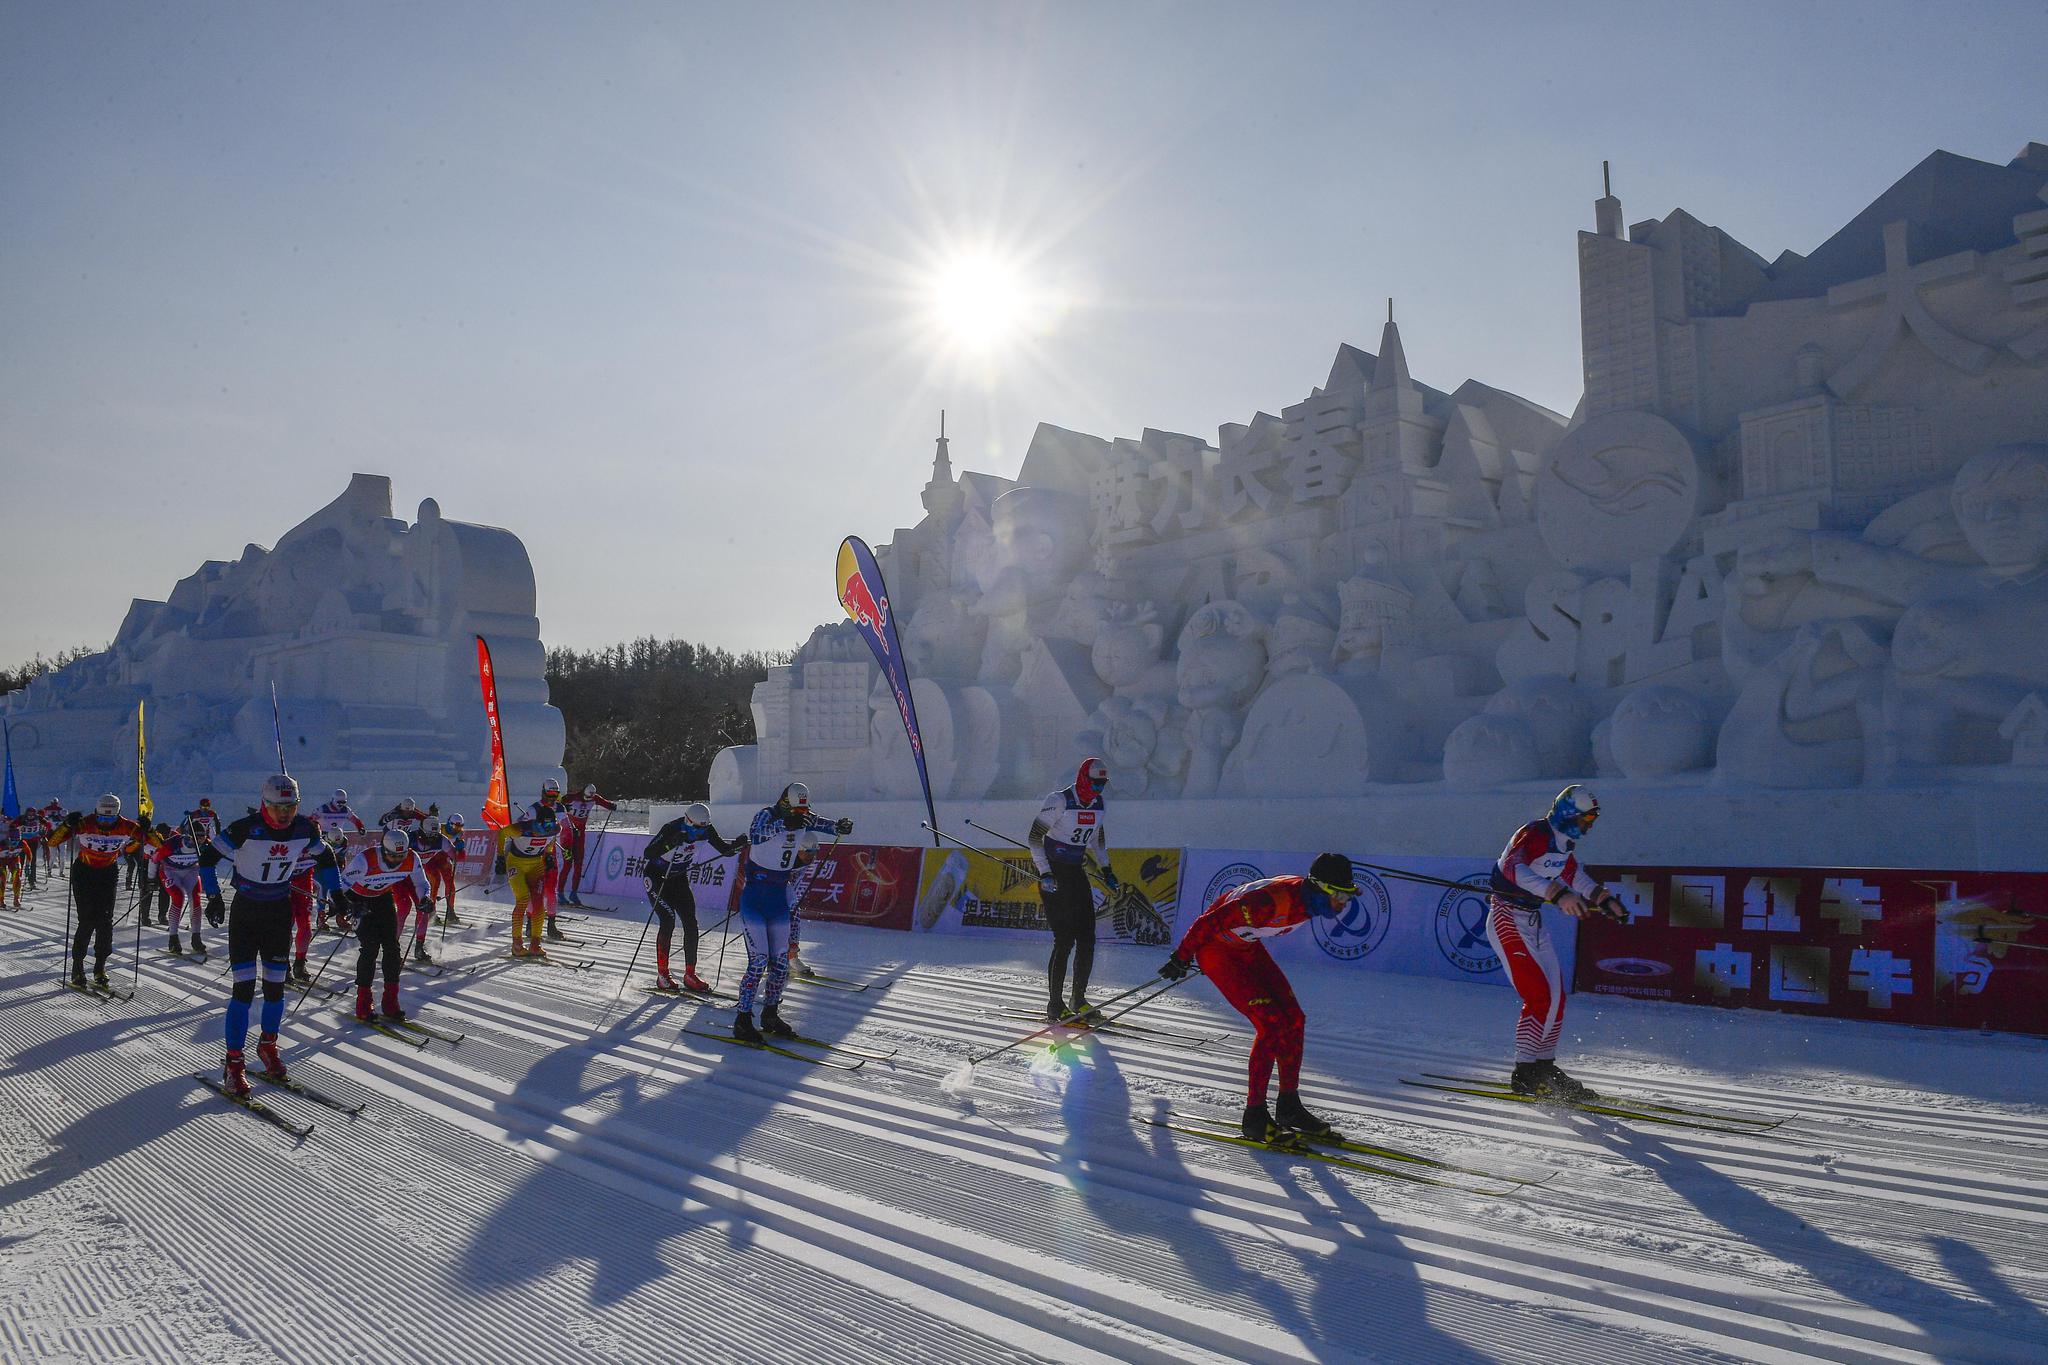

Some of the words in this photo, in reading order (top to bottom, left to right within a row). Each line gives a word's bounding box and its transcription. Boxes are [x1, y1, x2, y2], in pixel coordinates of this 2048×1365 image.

[1088, 397, 1352, 546] 魅力长春
[1070, 827, 1094, 844] 30
[780, 850, 792, 869] 9
[261, 861, 292, 882] 17
